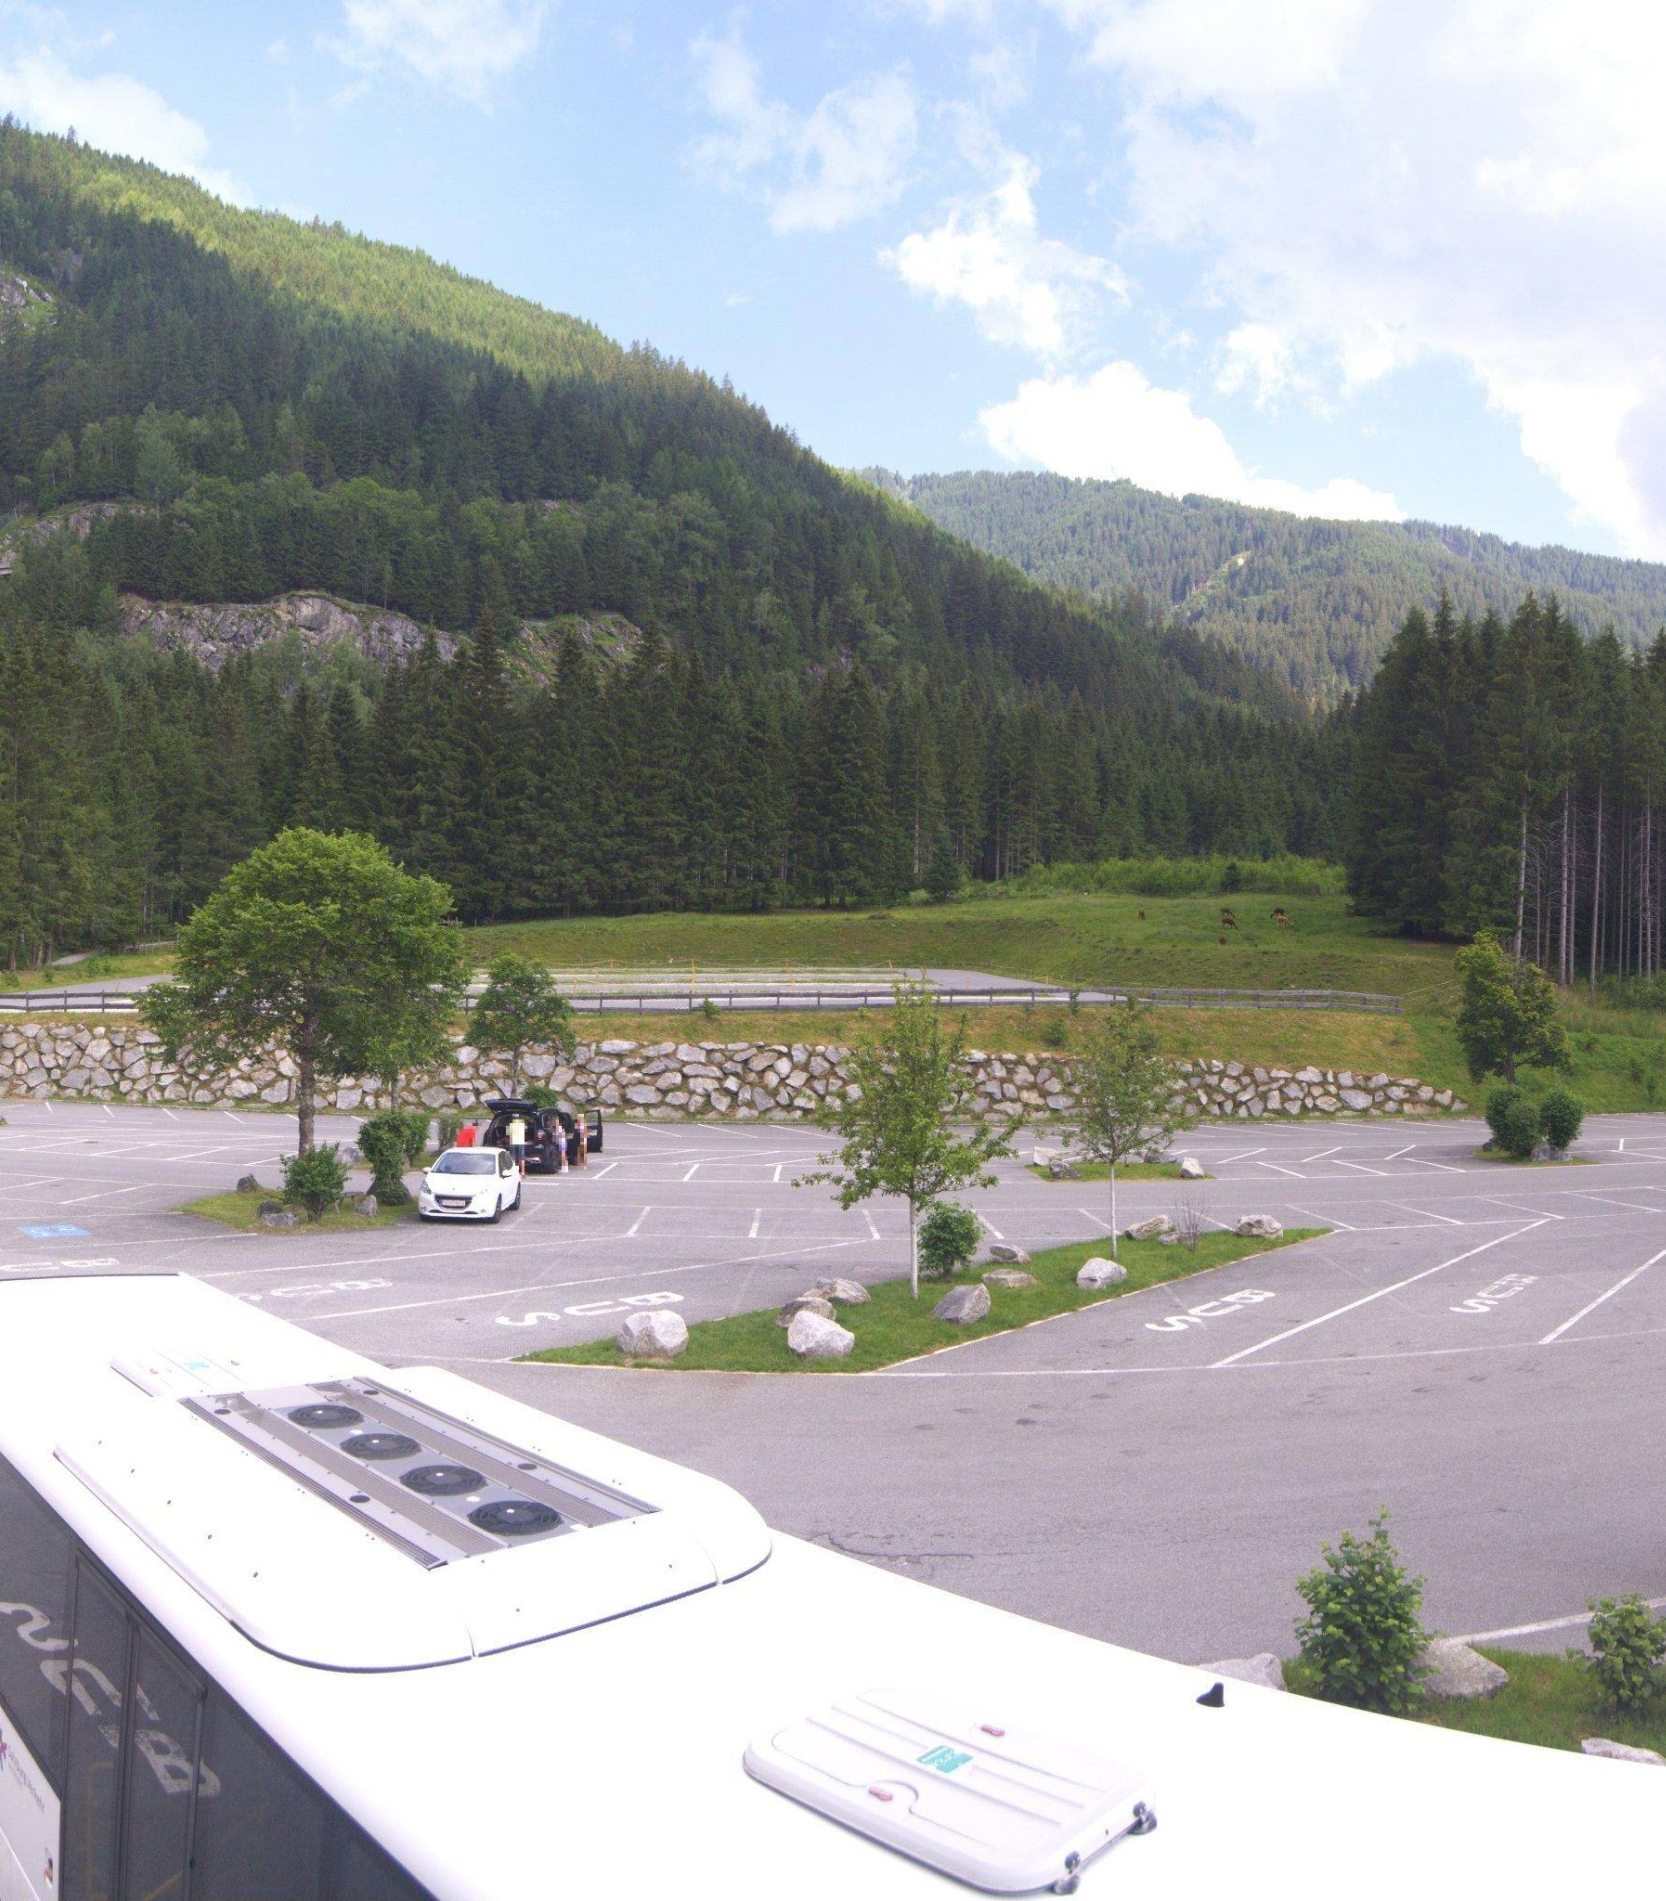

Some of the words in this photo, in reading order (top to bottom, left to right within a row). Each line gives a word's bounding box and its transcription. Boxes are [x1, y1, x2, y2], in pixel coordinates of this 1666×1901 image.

[495, 1291, 684, 1328] BUS
[1144, 1288, 1276, 1332] BUS
[1449, 1273, 1538, 1315] BUS
